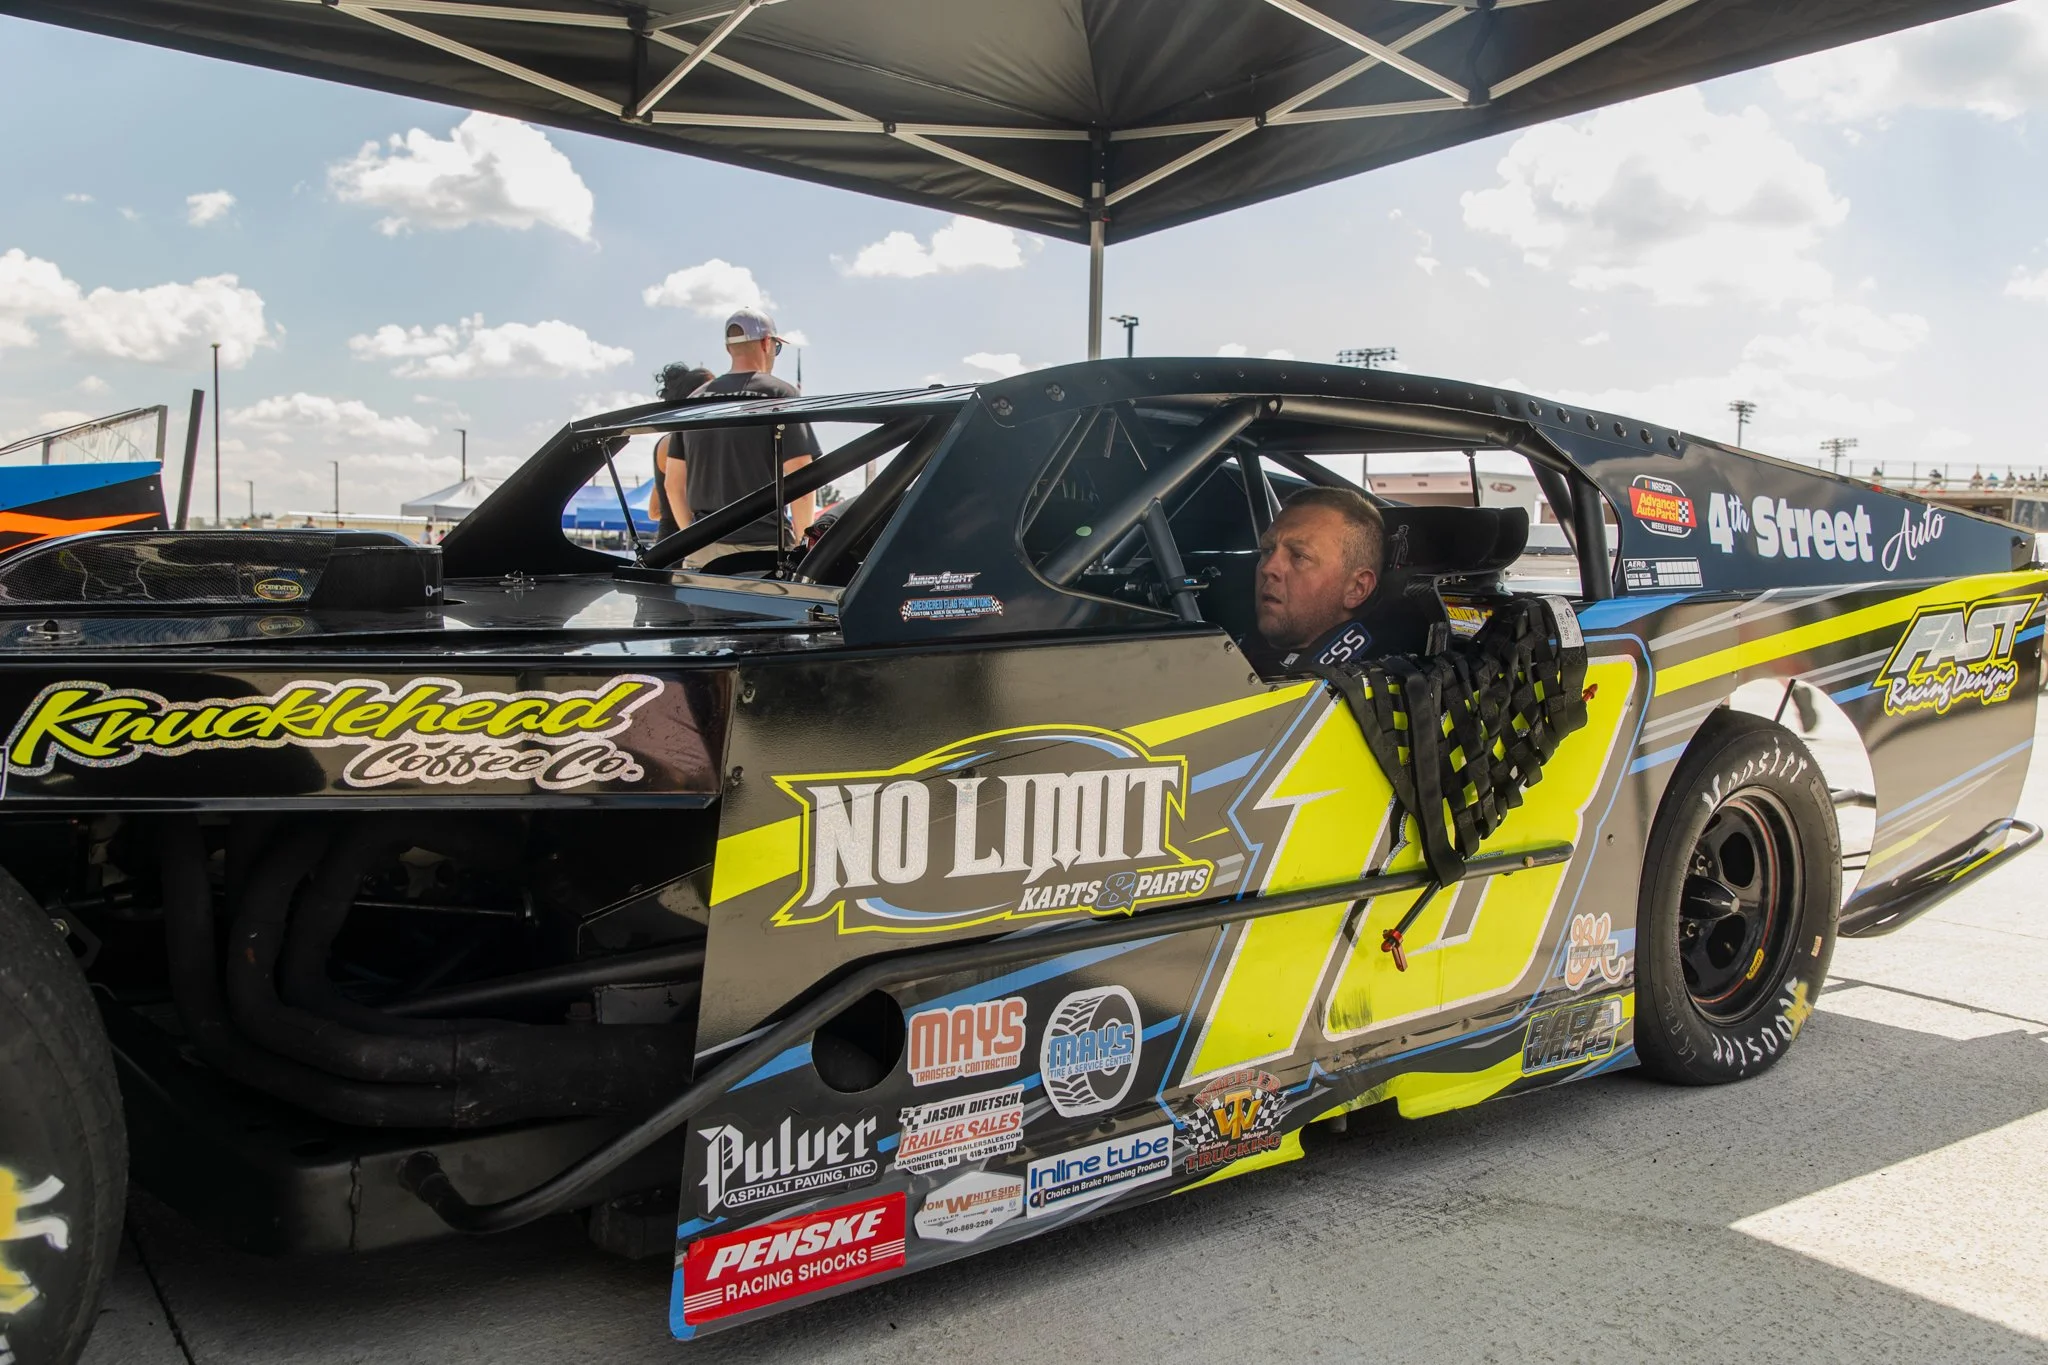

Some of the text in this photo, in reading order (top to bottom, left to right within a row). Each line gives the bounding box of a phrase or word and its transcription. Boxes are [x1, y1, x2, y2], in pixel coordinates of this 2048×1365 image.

[1636, 504, 1676, 521] Auto Parts
[1640, 493, 1676, 511] Advance
[1651, 522, 1683, 533] WEEKLY SERIES
[1708, 492, 1873, 562] 4th Street
[1881, 503, 1946, 571] Auto
[1627, 561, 1646, 569] AERO
[912, 597, 992, 611] CHECKERED FLAG PROMOTIONS
[1447, 607, 1483, 624] ENNY'S
[1888, 602, 2032, 674] FAST
[1888, 676, 1951, 707] Racing
[1952, 666, 2015, 698] Designs
[10, 682, 646, 766] Knucklehead
[351, 740, 641, 783] Coffee Co.
[803, 765, 1181, 908] NO LIMIT
[1018, 868, 1210, 912] KARTS & PARTS
[911, 1000, 1024, 1069] MAYS
[1049, 1023, 1134, 1069] MAYS
[915, 1066, 956, 1084] TRANSFER
[964, 1054, 1018, 1074] CONTRACTING
[1049, 1054, 1131, 1078] TIRE & SERVICE CENTER
[923, 1091, 1019, 1125] JASON DIETSCH
[1193, 1069, 1281, 1110] WHEELER
[897, 1131, 1022, 1167] JASONDIETSCHTRAILERSALES.COM
[899, 1111, 1021, 1154] TRAILER SALES
[1107, 1136, 1169, 1167] tube
[1185, 1131, 1282, 1171] TRUCKING
[697, 1115, 877, 1214] Pulver
[948, 1155, 958, 1164] OH
[1046, 1189, 1071, 1200] Choice
[1072, 1184, 1080, 1193] in
[1081, 1178, 1102, 1191] Brake
[1103, 1166, 1136, 1183] Plumbing
[1137, 1158, 1167, 1174] Products
[727, 1162, 874, 1205] ASPHALT PAVING, INC.
[946, 1184, 1022, 1214] WHITESIDE
[706, 1206, 887, 1281] PENSKE
[726, 1247, 868, 1302] RACING SHOCKS
